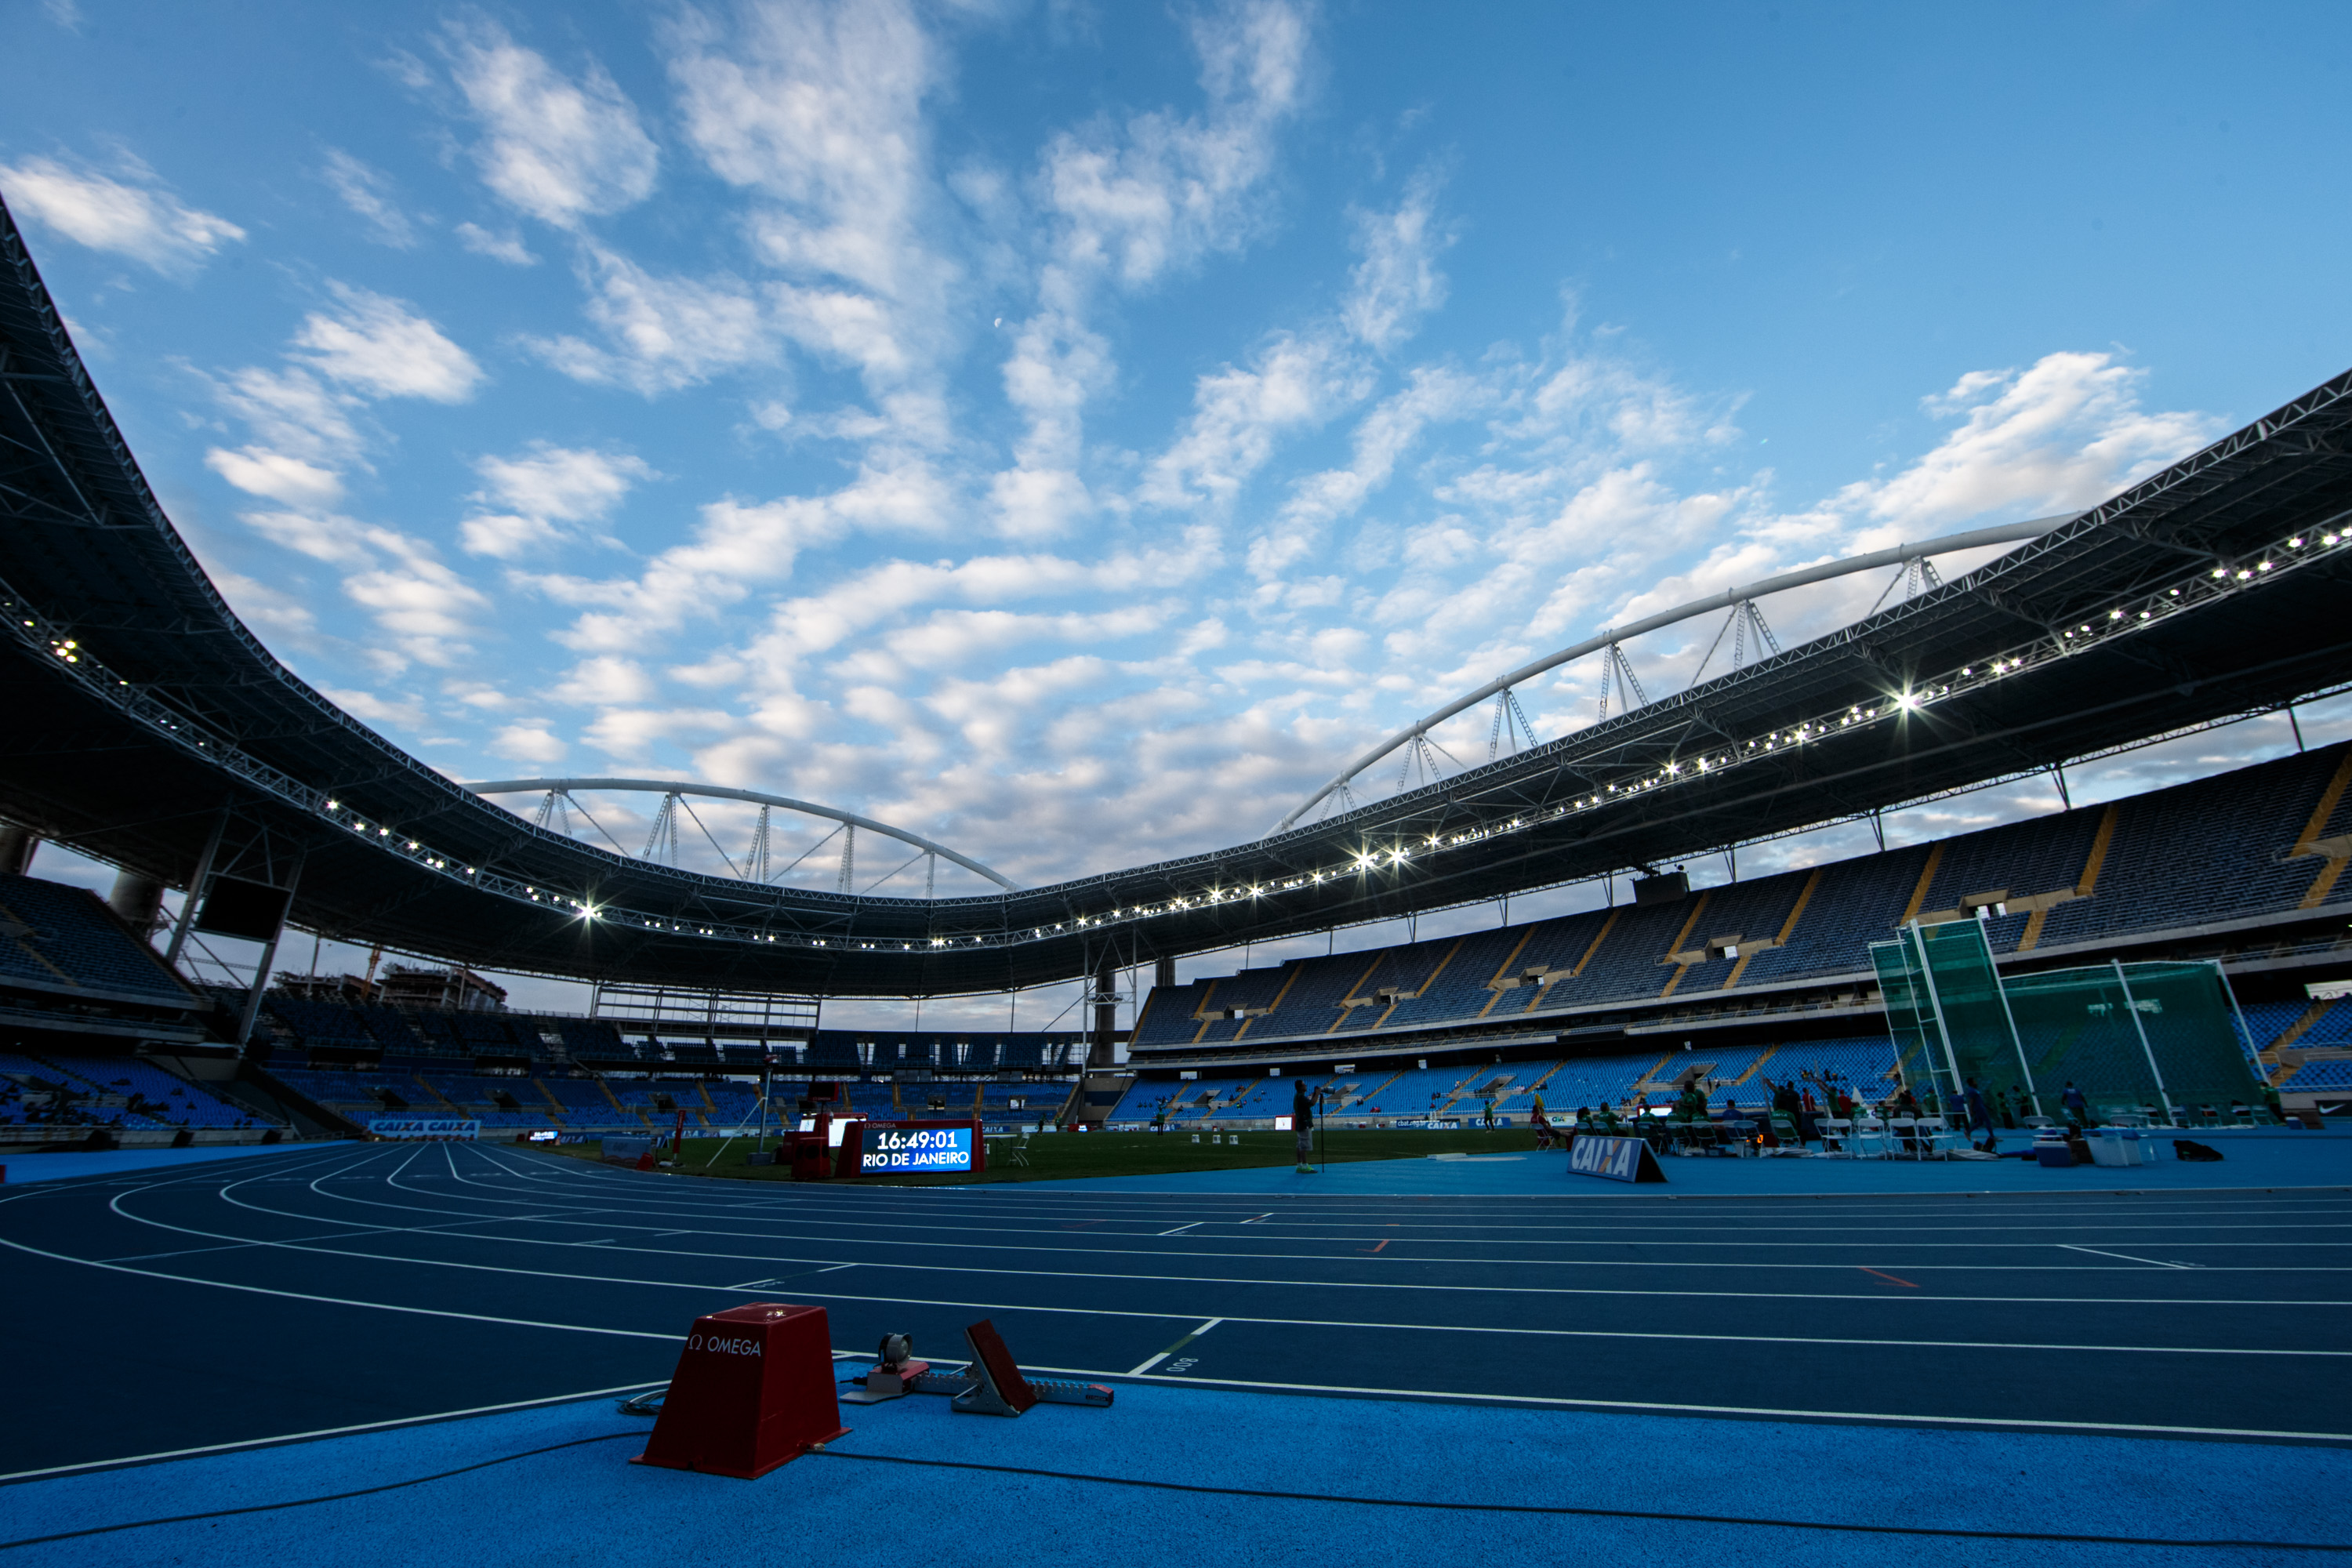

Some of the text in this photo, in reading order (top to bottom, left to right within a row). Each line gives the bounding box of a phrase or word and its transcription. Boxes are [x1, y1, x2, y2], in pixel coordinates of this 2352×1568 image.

[374, 1122, 476, 1131] CAIXA CAIXA
[877, 1131, 958, 1150] 16:49:01
[862, 1151, 970, 1167] RIO DE JANEIRO
[1572, 1138, 1632, 1177] CAIXA
[707, 1336, 761, 1357] OMEGA
